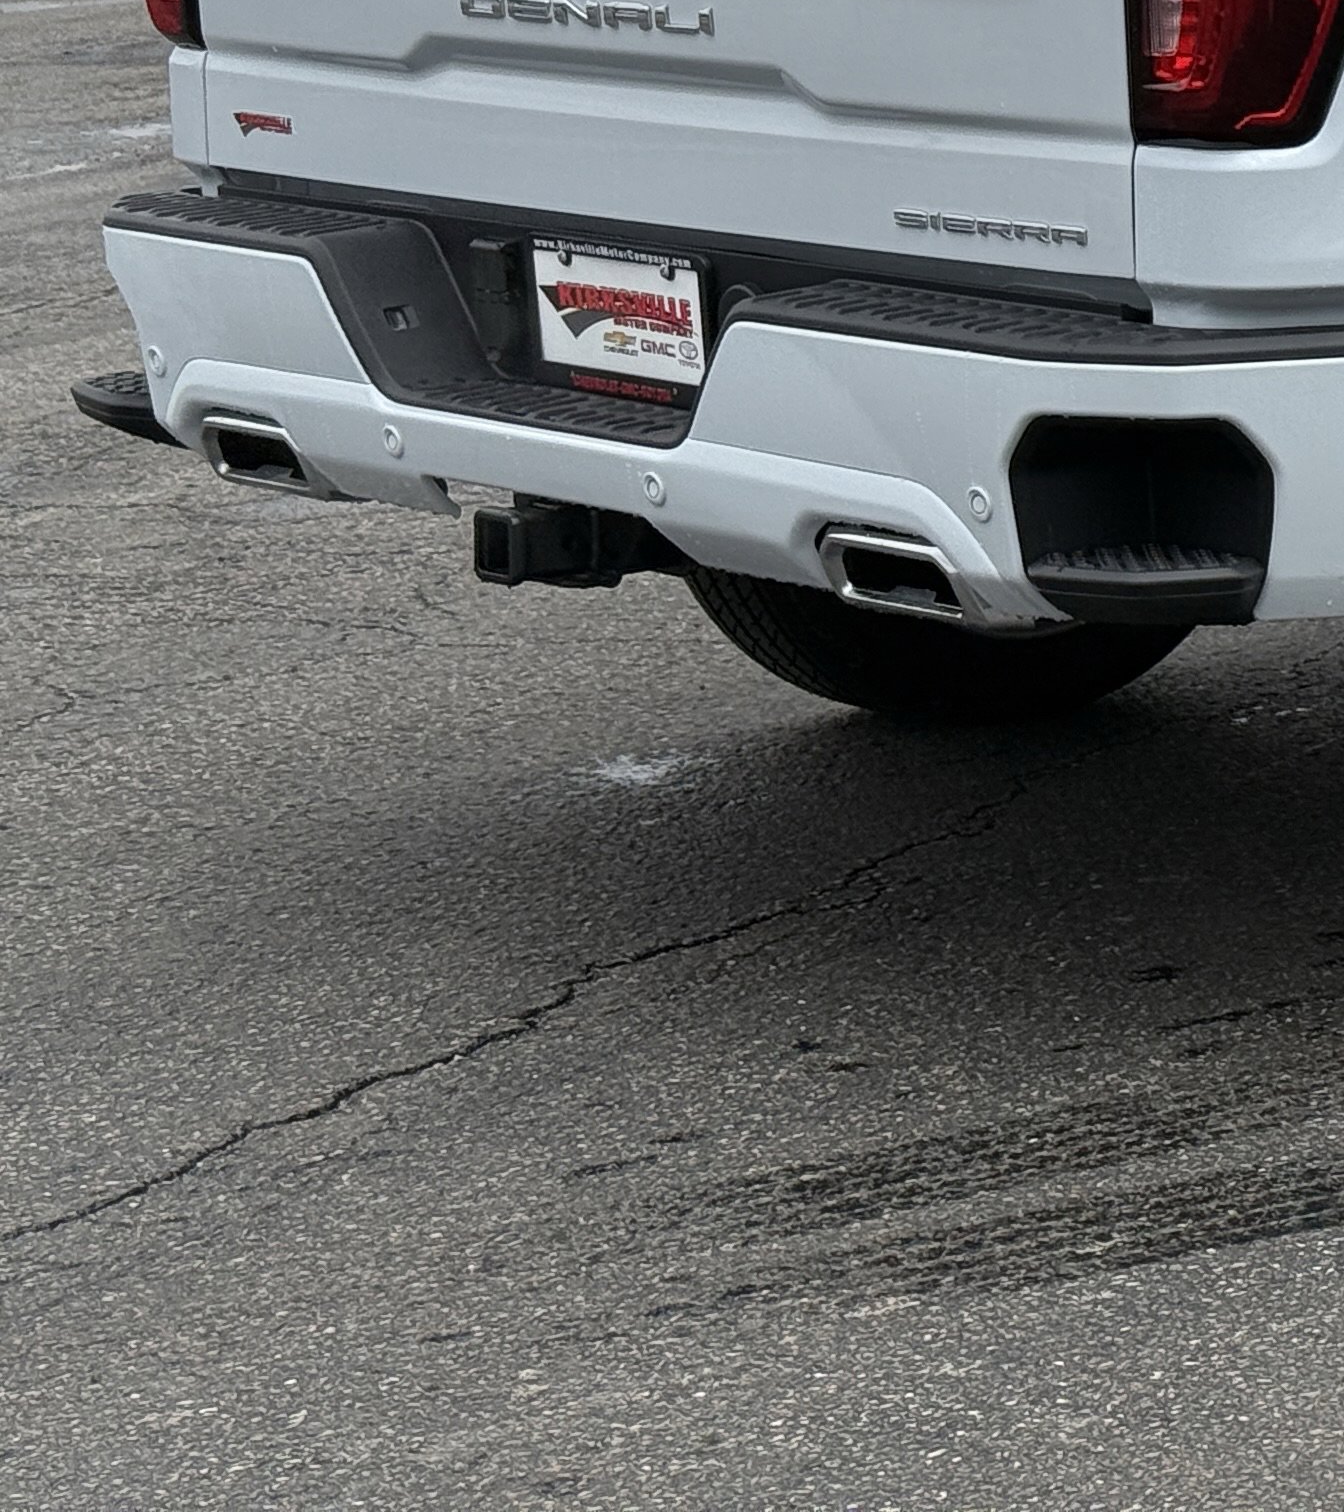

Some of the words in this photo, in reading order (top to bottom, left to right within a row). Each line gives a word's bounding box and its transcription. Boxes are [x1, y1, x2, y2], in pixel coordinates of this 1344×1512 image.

[893, 207, 1088, 247] SIERRA
[556, 281, 693, 325] KIRKSVILLE
[641, 339, 676, 358] GMC
